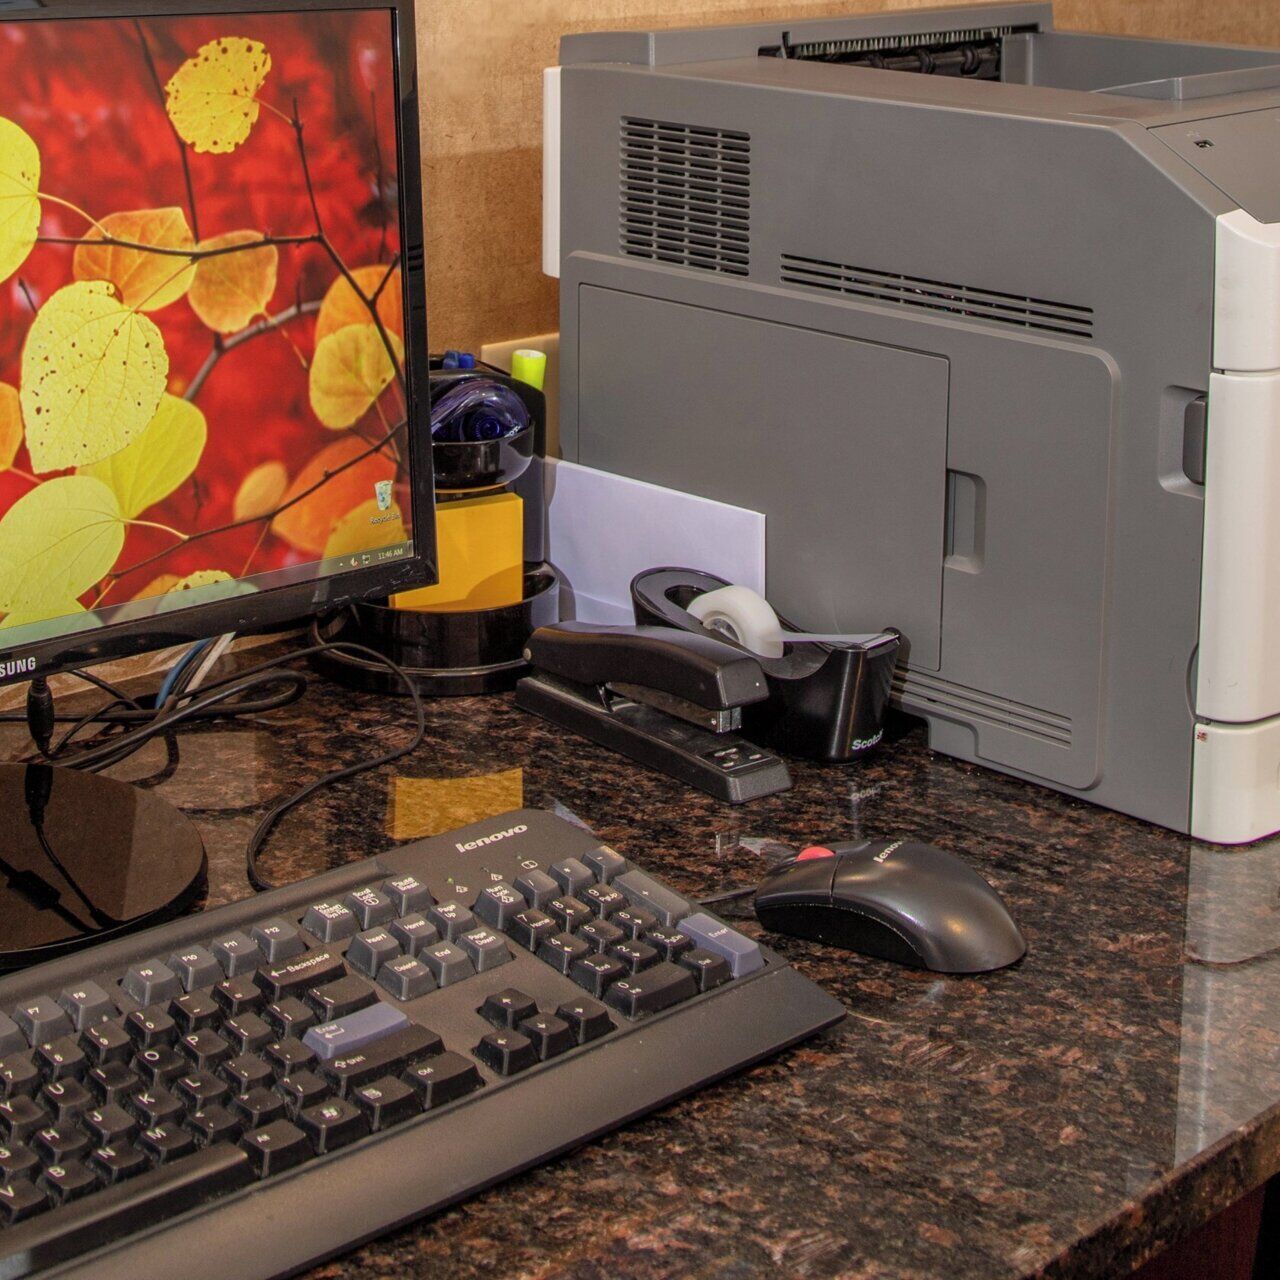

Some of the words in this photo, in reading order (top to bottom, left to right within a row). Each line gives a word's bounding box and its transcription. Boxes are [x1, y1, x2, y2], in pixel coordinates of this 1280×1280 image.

[455, 824, 528, 853] lenovo
[404, 920, 426, 931] Home
[708, 928, 729, 938] Enter
[475, 935, 496, 946] Down
[435, 949, 452, 958] End
[286, 953, 329, 972] Backspace
[394, 961, 418, 972] Delete
[315, 1024, 338, 1034] Enter
[187, 1035, 199, 1045] P
[185, 1078, 201, 1087] L
[48, 1083, 65, 1095] U
[138, 1093, 155, 1105] K
[0, 1101, 13, 1112] Y
[93, 1111, 103, 1122] J
[41, 1128, 60, 1141] H
[146, 1127, 167, 1140] M
[97, 1146, 116, 1159] N
[47, 1166, 65, 1178] B
[0, 1185, 14, 1197] V
